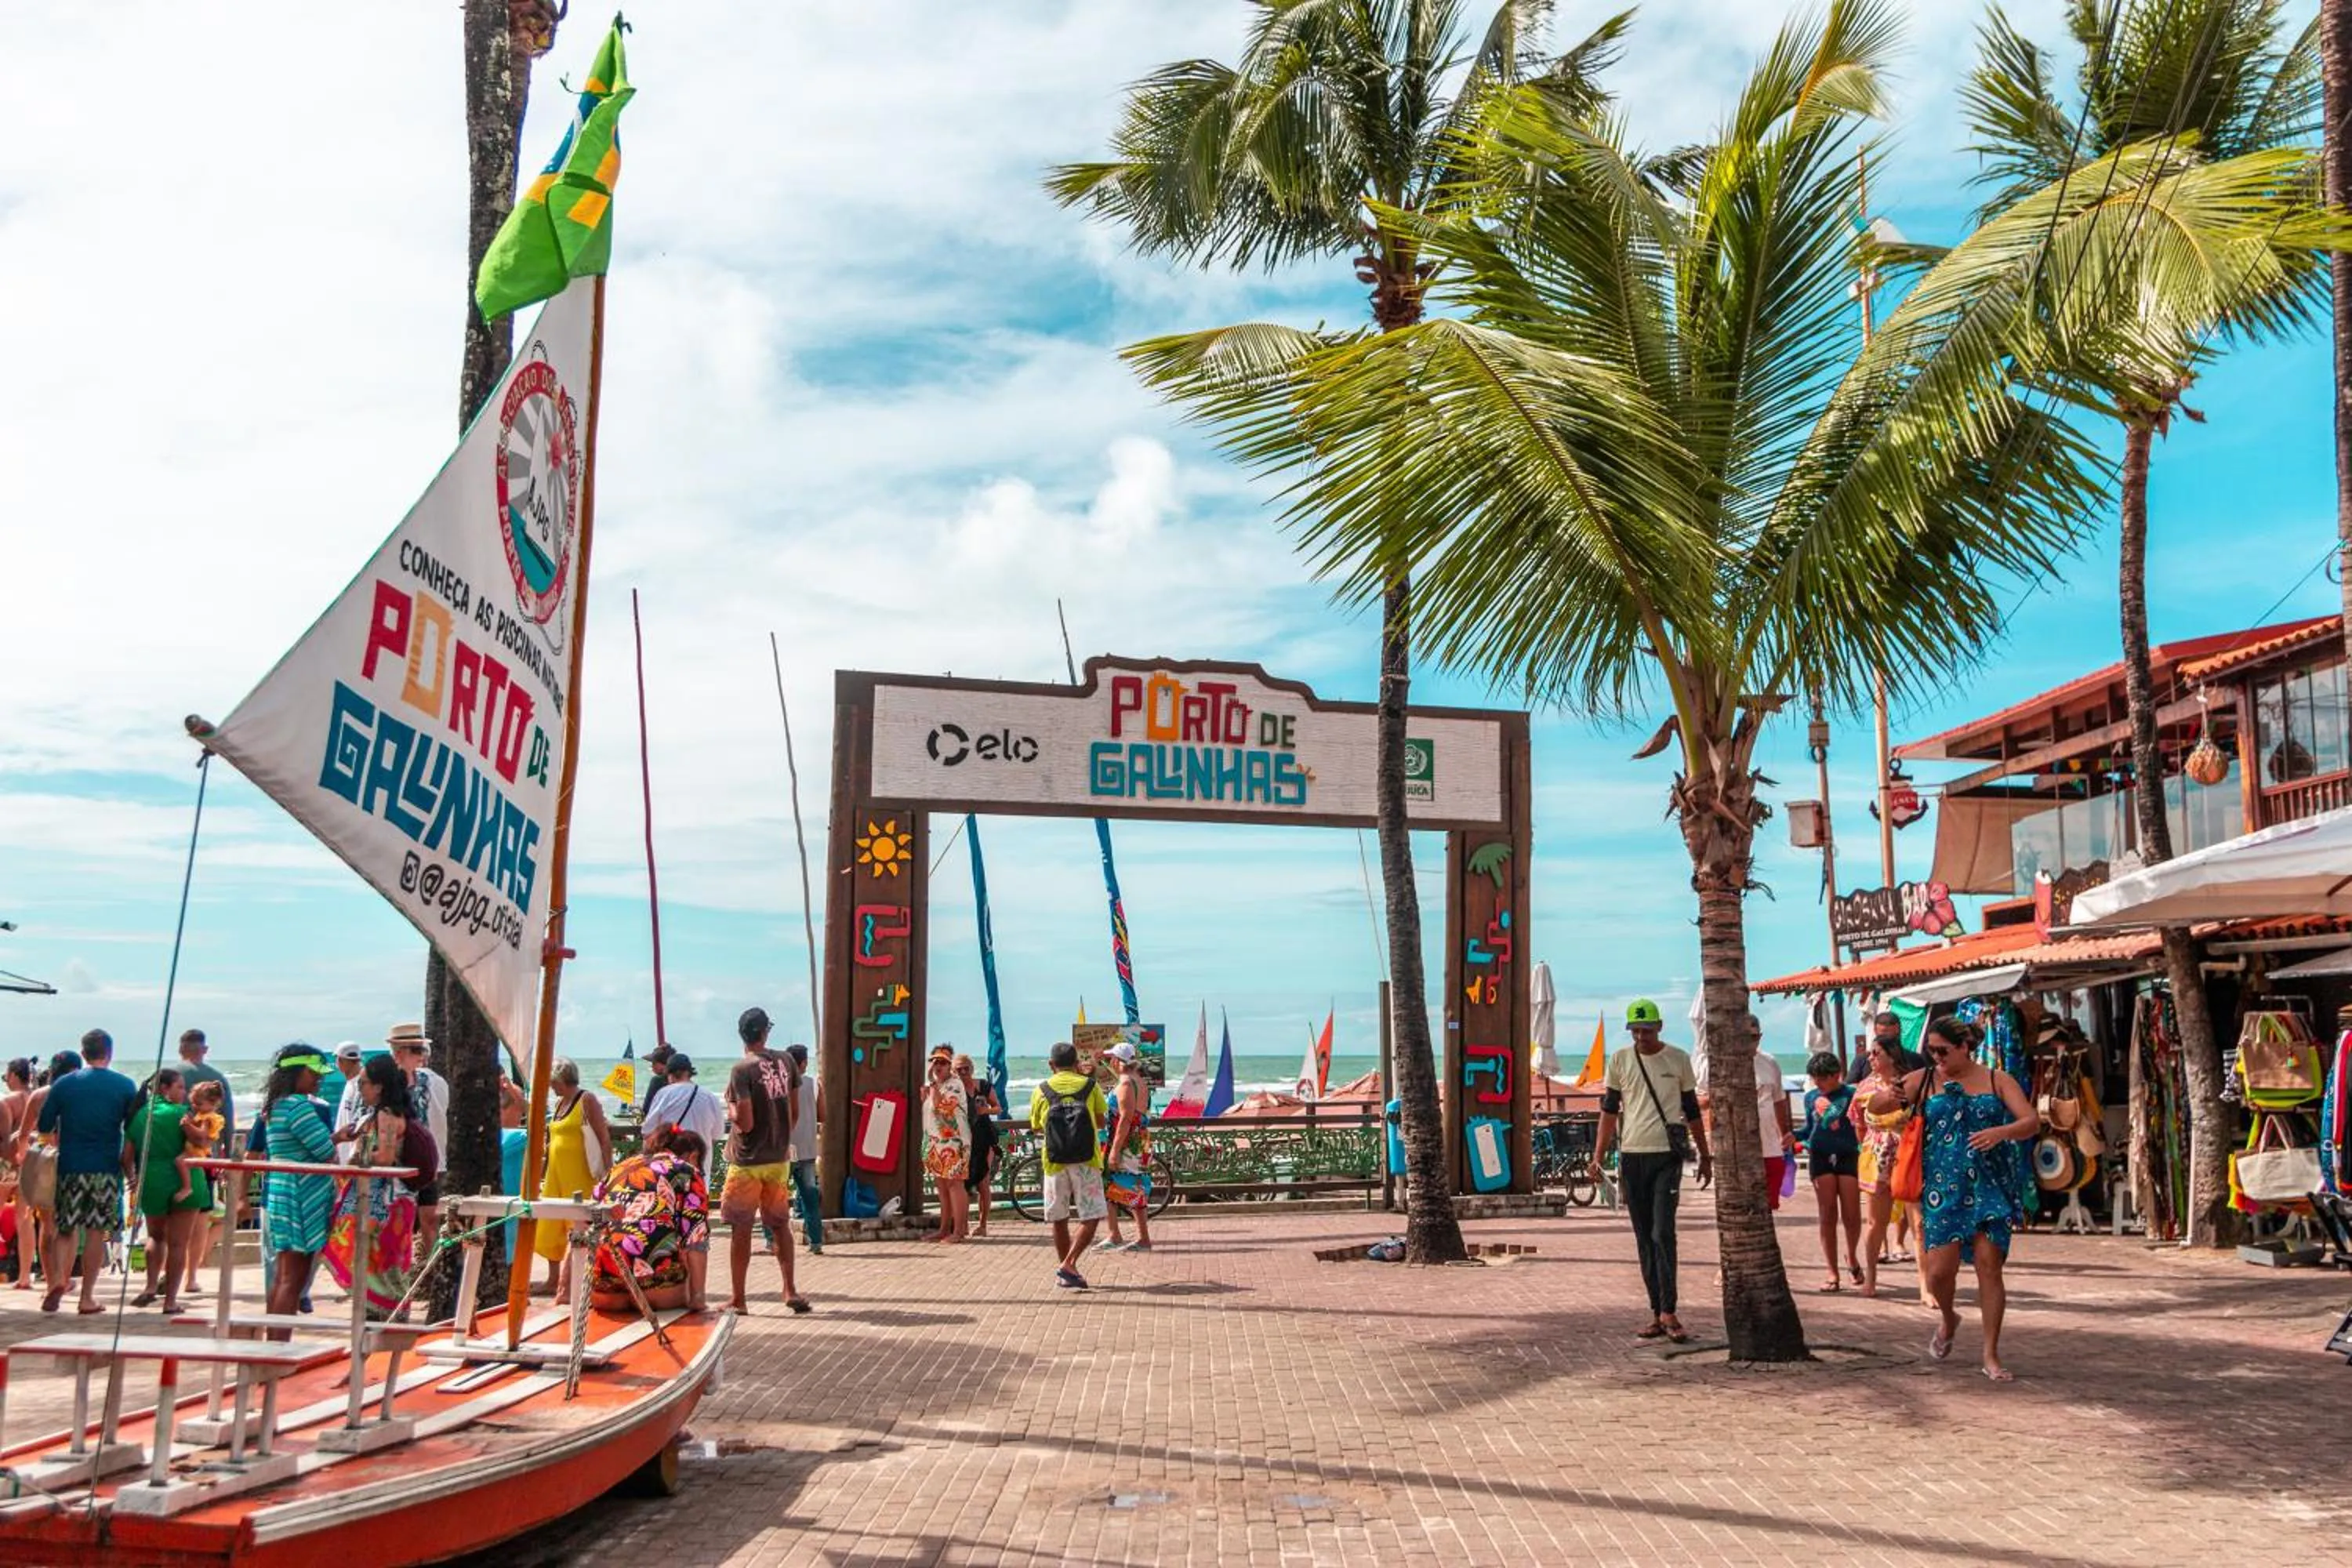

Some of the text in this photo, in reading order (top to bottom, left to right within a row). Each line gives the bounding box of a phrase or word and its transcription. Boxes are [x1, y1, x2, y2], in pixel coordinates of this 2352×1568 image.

[400, 539, 470, 615] CONHEÇA
[474, 596, 494, 632] AS
[495, 610, 542, 678] PISCINAS
[361, 579, 550, 788] PORTO DE
[1111, 671, 1298, 748] PORTO DE
[318, 680, 540, 916] GALINHAS
[1090, 742, 1308, 806] GALINHAS
[1900, 883, 1929, 924] BAR
